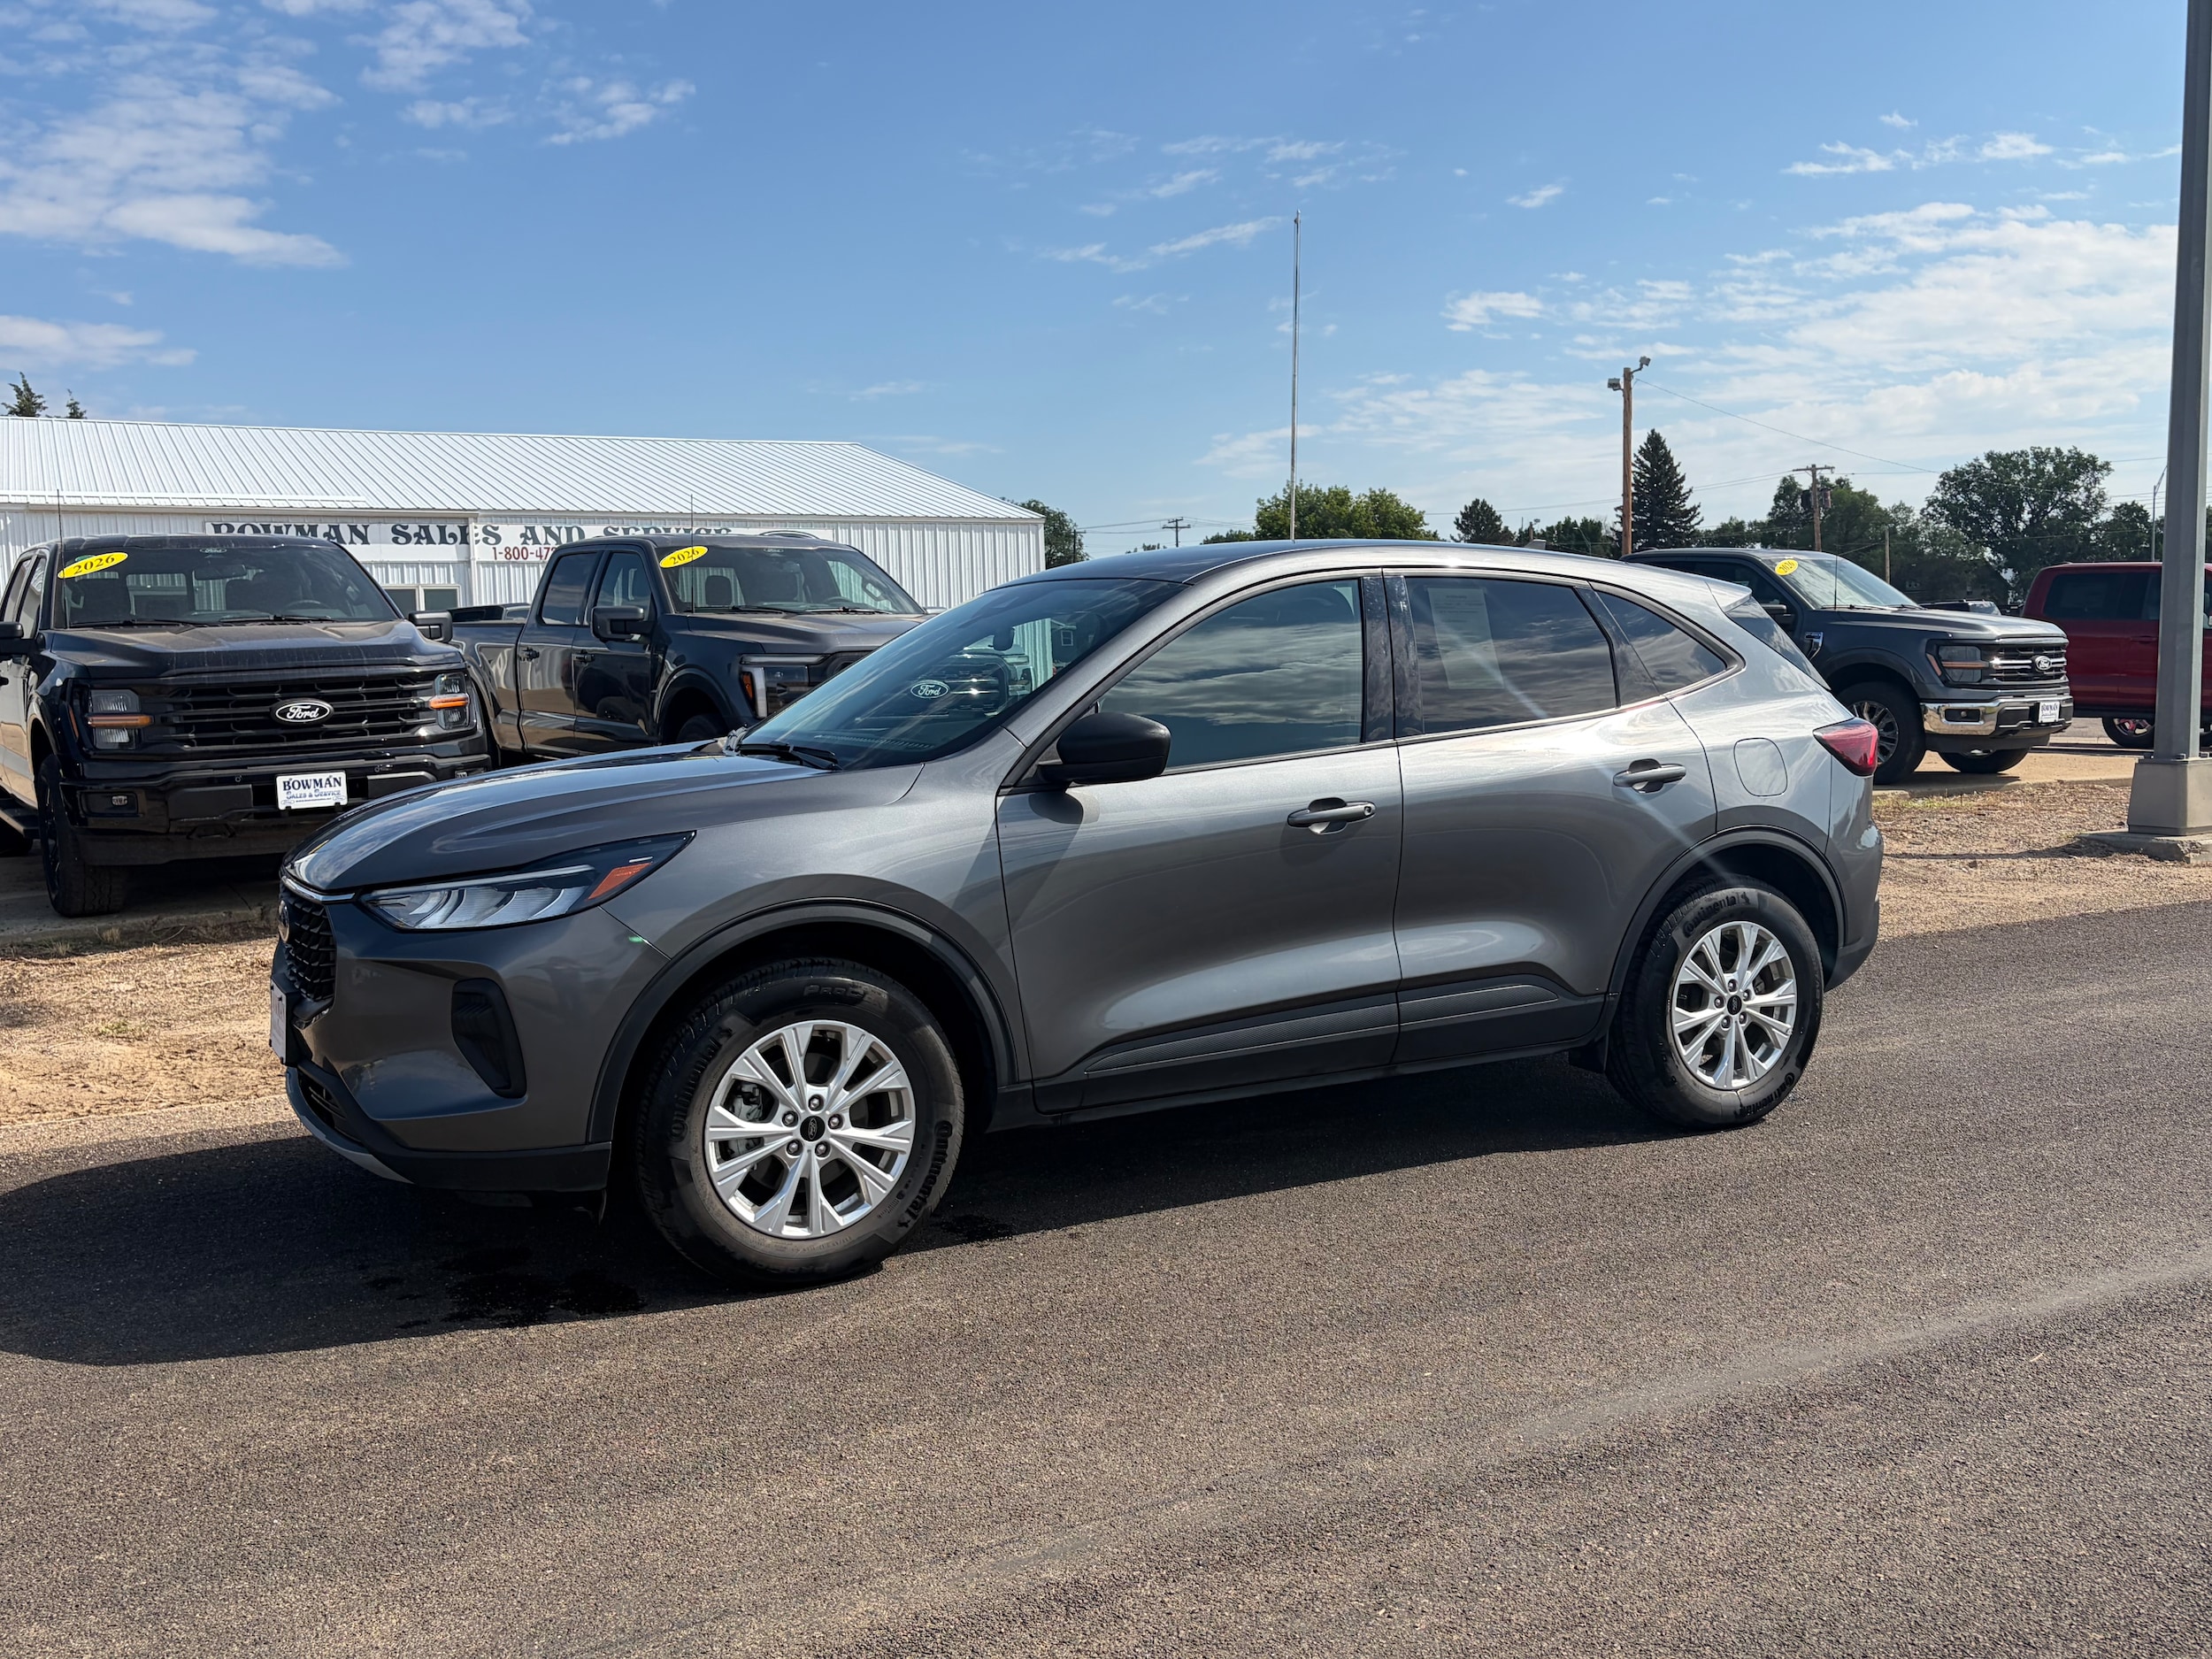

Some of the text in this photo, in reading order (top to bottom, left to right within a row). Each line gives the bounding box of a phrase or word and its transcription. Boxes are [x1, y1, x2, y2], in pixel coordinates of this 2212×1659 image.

[520, 525, 586, 545] AND
[73, 554, 115, 574] 2026
[670, 549, 700, 565] 2026
[918, 684, 941, 695] Ford
[286, 705, 319, 718] Ford
[282, 776, 342, 791] BOWMAN
